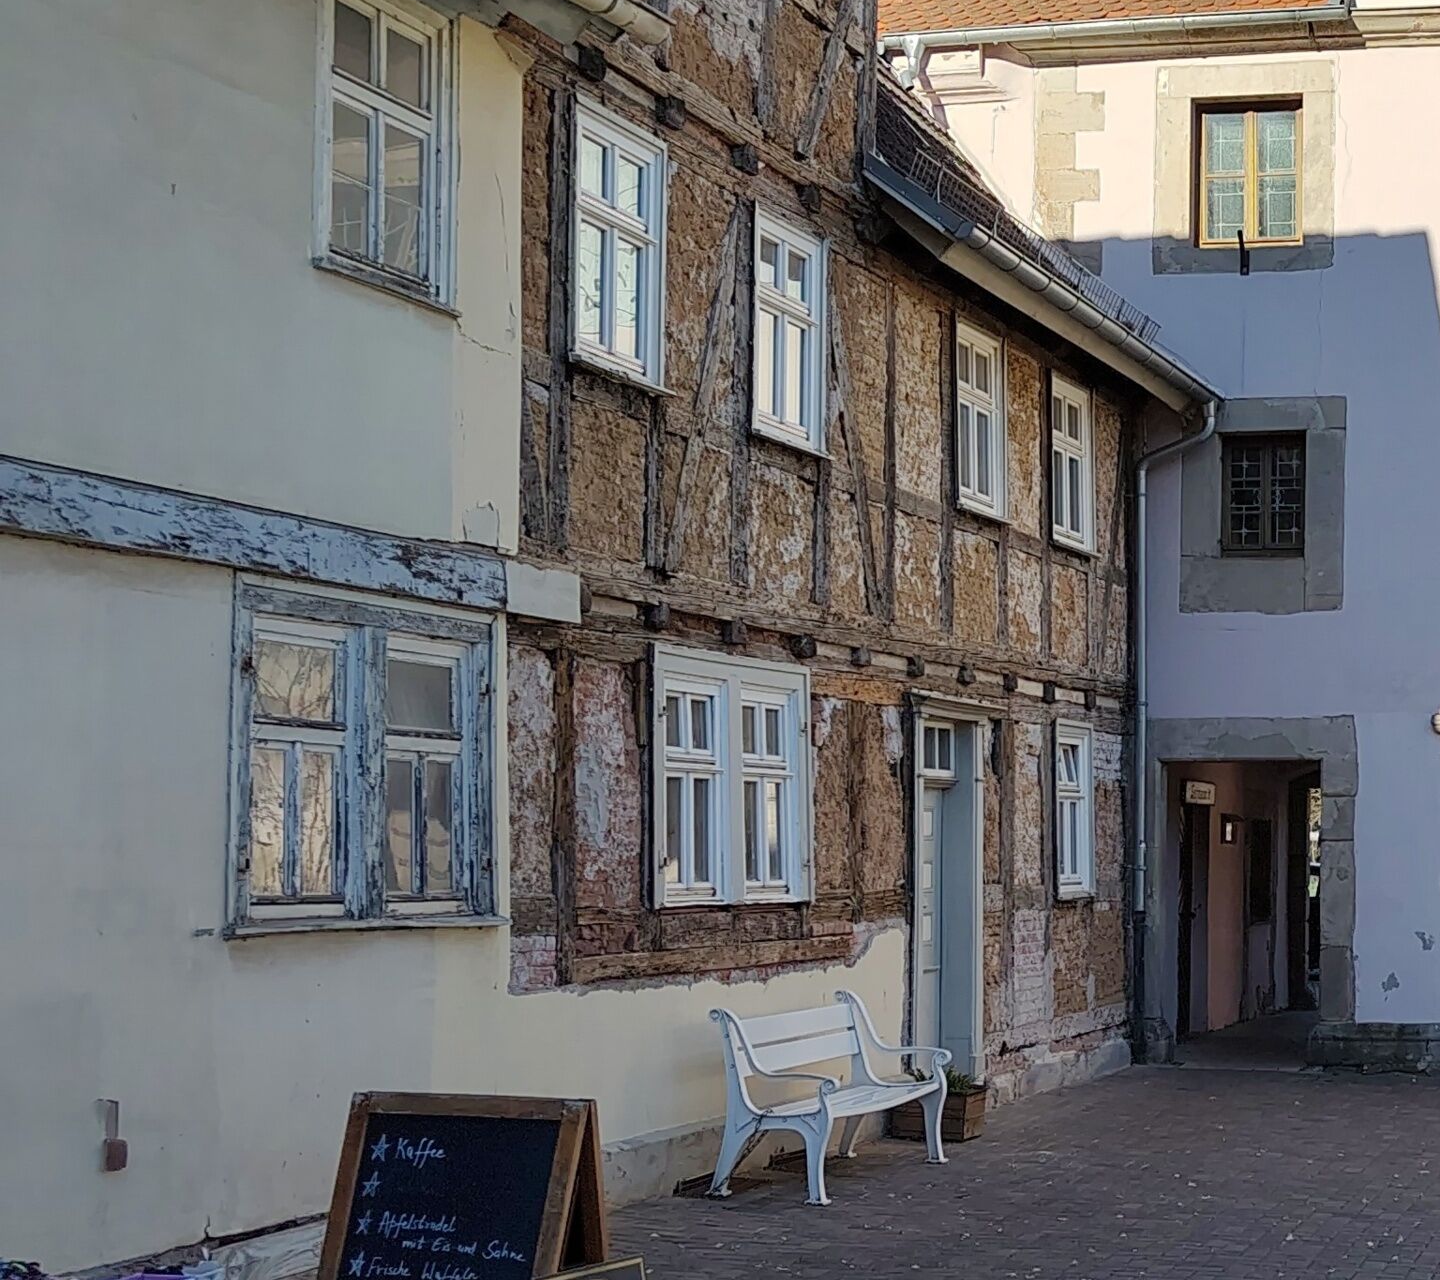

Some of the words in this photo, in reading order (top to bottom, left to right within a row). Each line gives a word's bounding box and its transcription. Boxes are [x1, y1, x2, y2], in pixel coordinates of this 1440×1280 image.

[395, 1137, 446, 1169] Kaffee
[378, 1210, 456, 1238] Apfelstrudel
[402, 1236, 426, 1250] mit
[431, 1237, 451, 1252] Eis
[457, 1242, 477, 1256] und
[482, 1240, 526, 1262] Sahne
[365, 1256, 411, 1277] Frische
